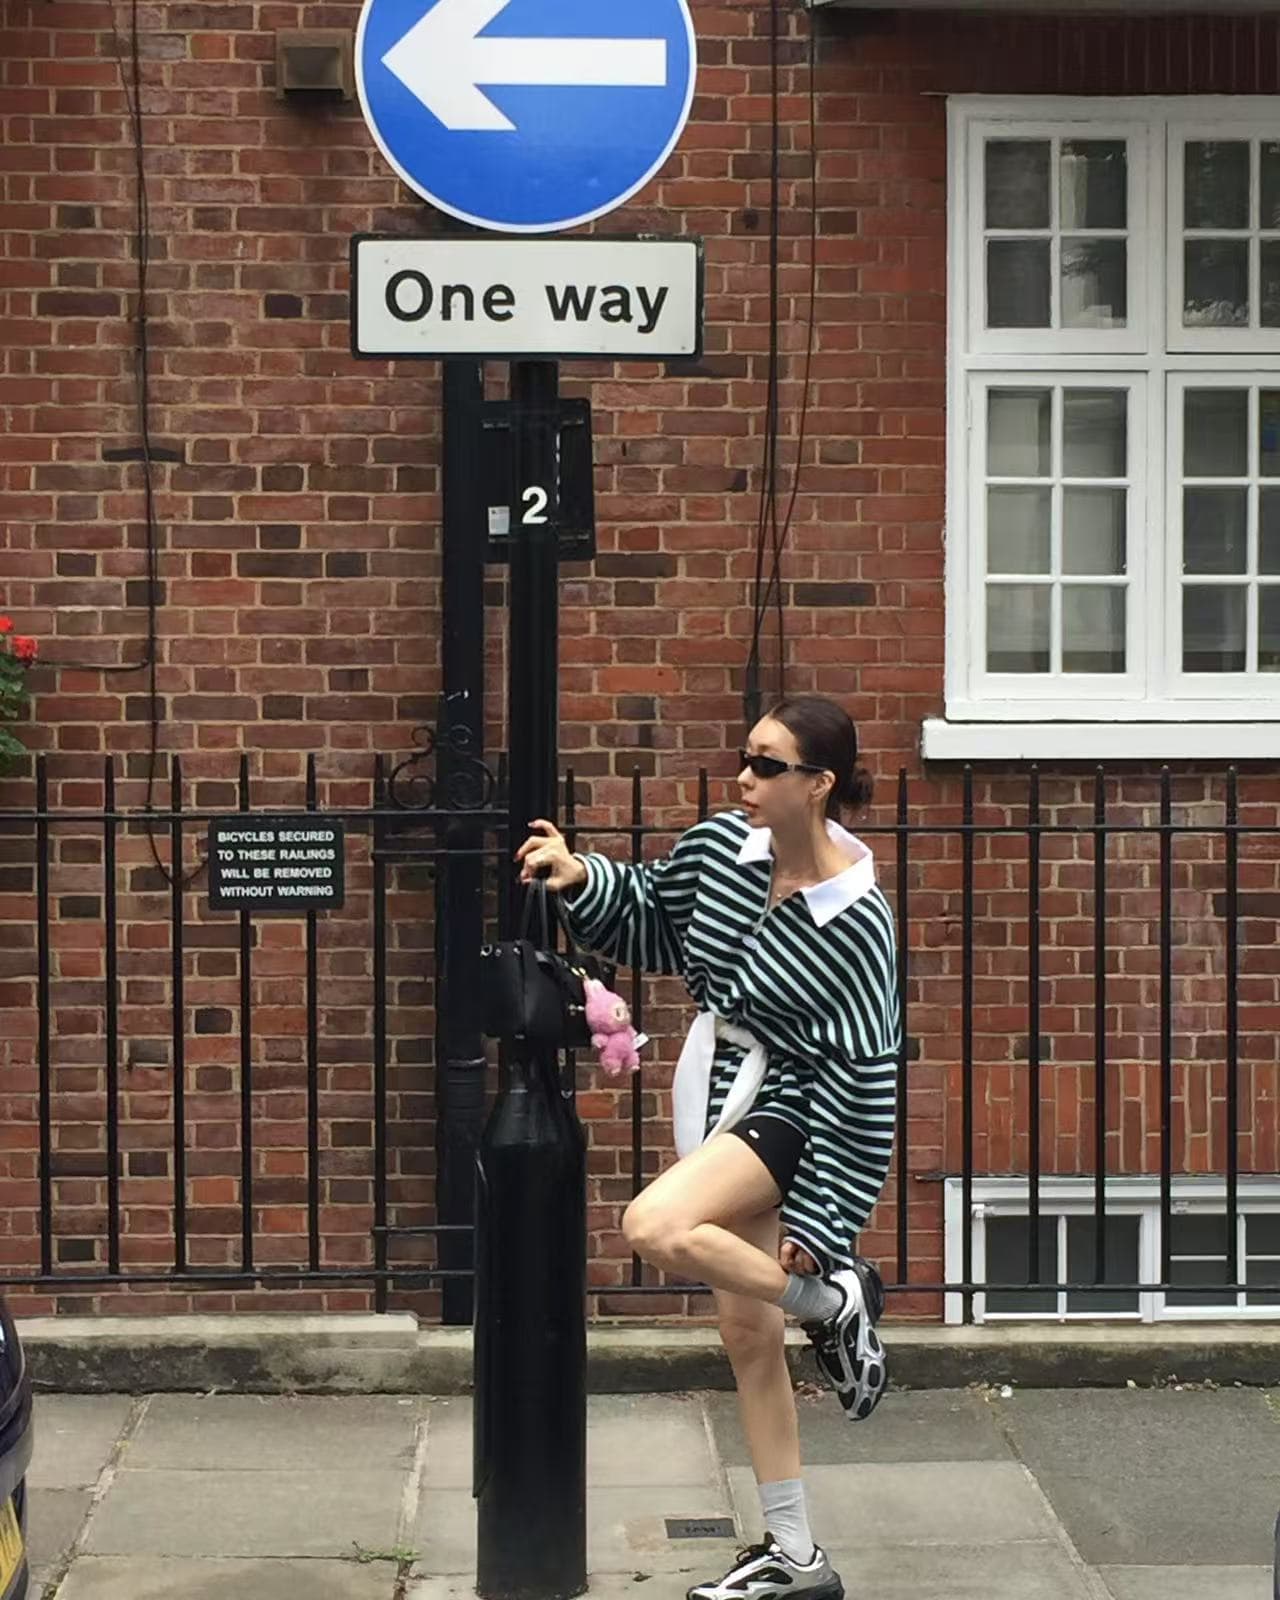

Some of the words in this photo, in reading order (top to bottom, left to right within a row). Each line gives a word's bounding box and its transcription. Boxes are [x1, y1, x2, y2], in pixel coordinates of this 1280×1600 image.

[385, 269, 516, 322] One
[545, 285, 669, 334] way
[522, 486, 548, 524] 2
[217, 831, 275, 842] BICYCLES
[278, 831, 335, 842] SECURED
[217, 849, 234, 860] TO
[237, 849, 276, 860] THESE
[279, 849, 335, 860] RAILINGS
[220, 867, 250, 879] WILL
[253, 867, 270, 879] BE
[273, 867, 333, 879] REMOVED
[219, 885, 274, 897] WITHOUT
[277, 885, 334, 897] WARNING
